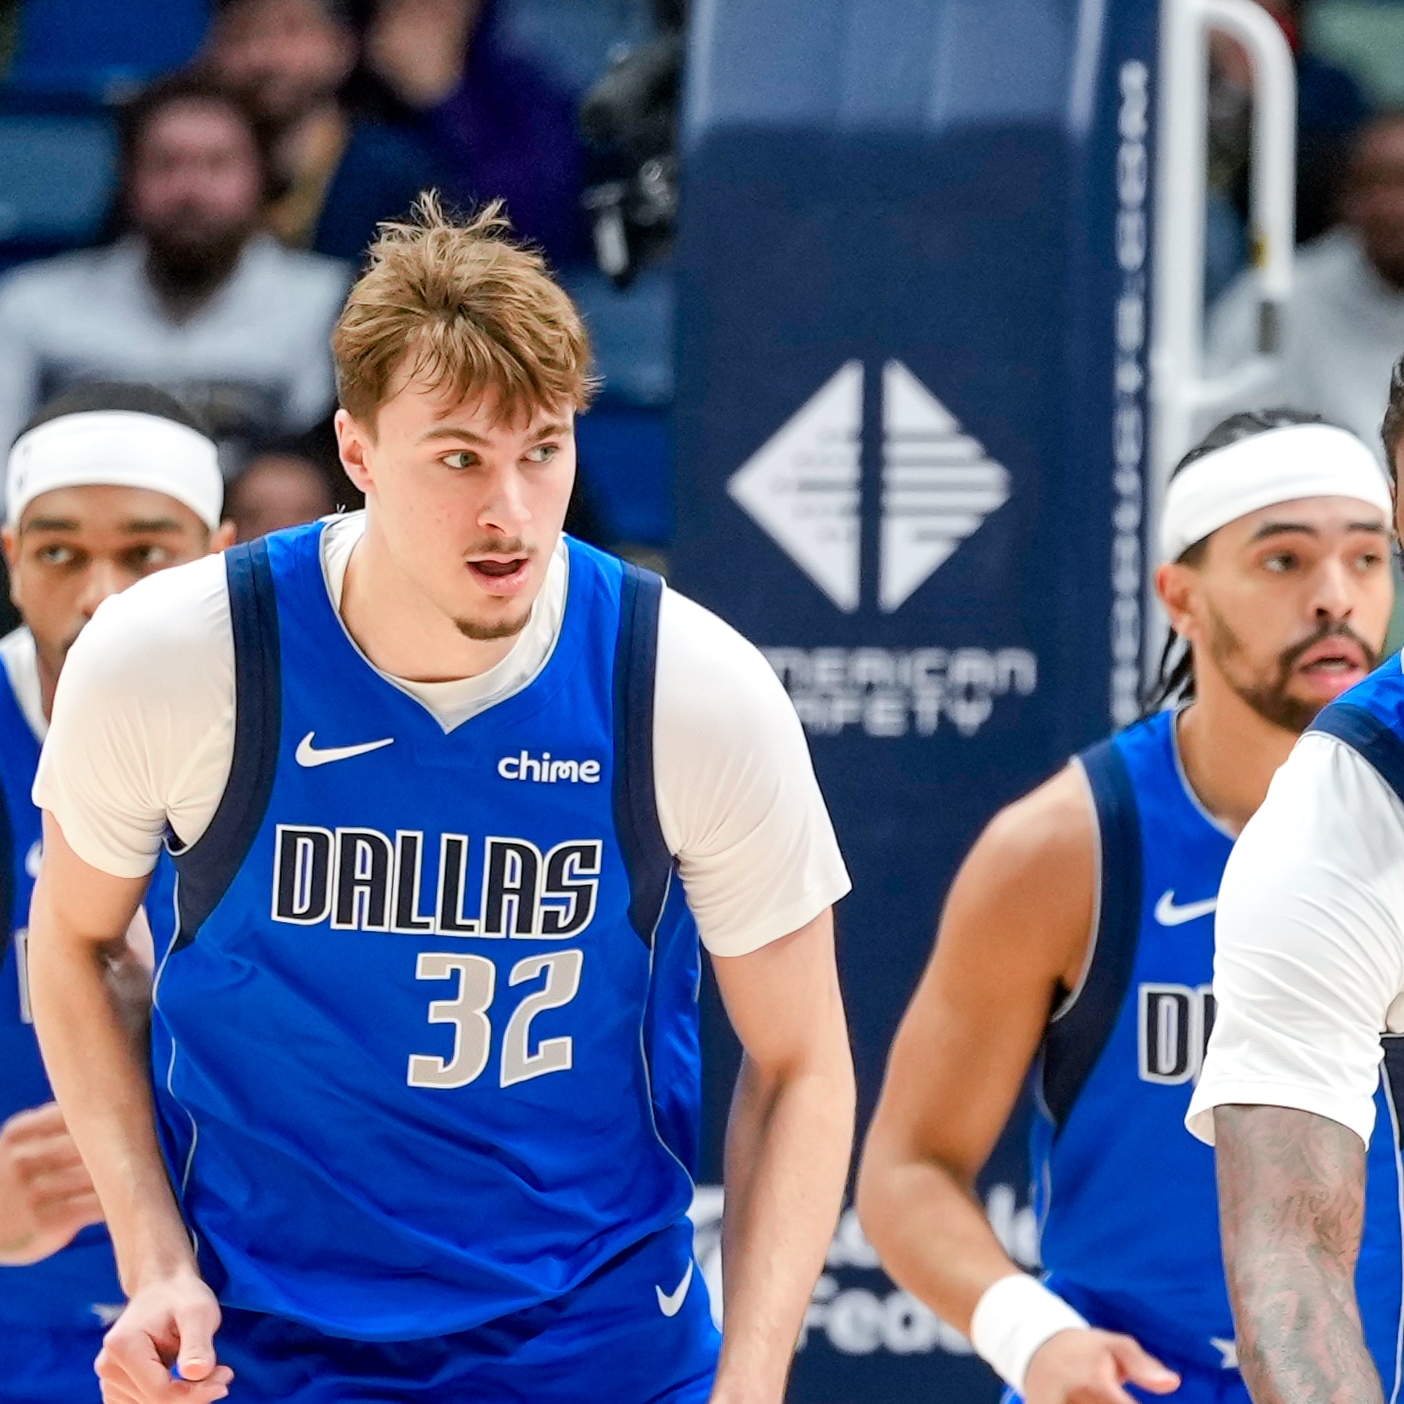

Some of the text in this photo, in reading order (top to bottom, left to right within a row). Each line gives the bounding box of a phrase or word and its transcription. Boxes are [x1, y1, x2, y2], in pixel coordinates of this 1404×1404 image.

[497, 749, 601, 784] chime
[271, 824, 603, 940] DALLAS
[407, 949, 585, 1090] 32
